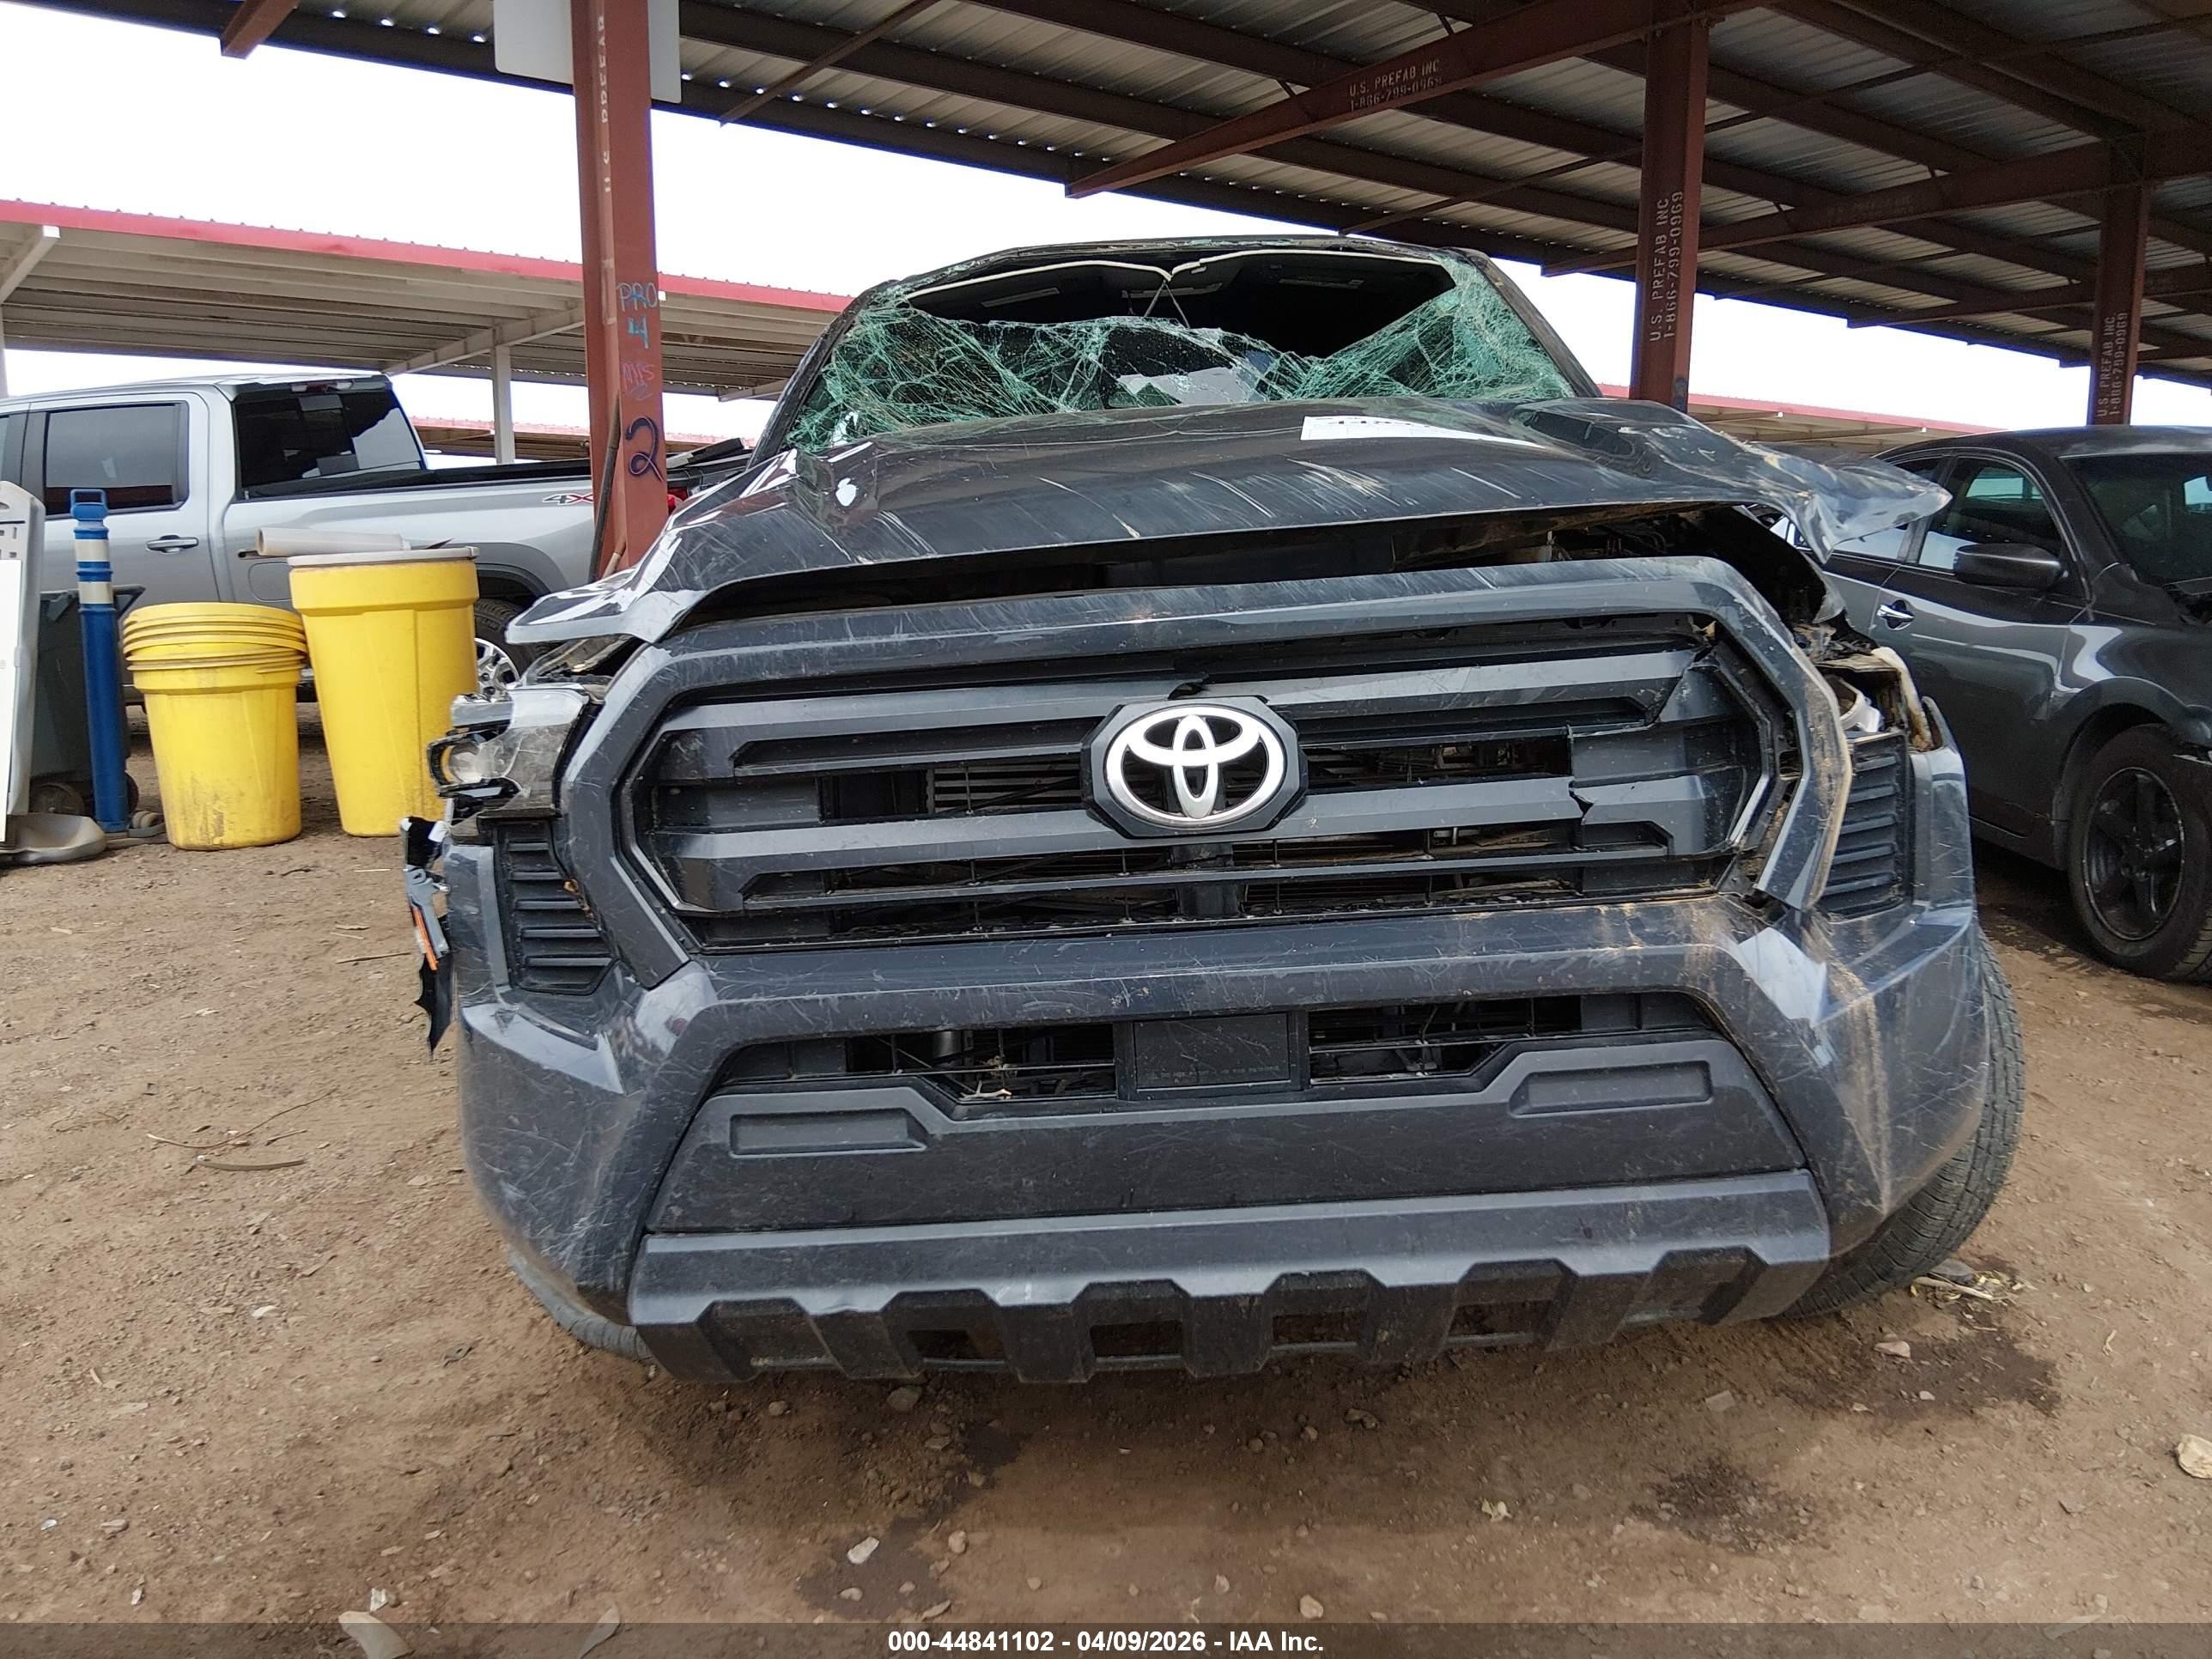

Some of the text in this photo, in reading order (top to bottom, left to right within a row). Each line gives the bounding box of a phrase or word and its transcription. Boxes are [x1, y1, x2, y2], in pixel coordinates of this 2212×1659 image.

[1375, 66, 1416, 90] PREFAB
[1421, 58, 1440, 76] INC
[1650, 198, 1669, 342] U.S. PREFAB INC
[1663, 191, 1683, 337] 1-866-799-0969
[617, 282, 658, 312] PRO
[627, 315, 649, 349] 4
[2100, 341, 2113, 388] PREFAB
[625, 416, 664, 482] 2
